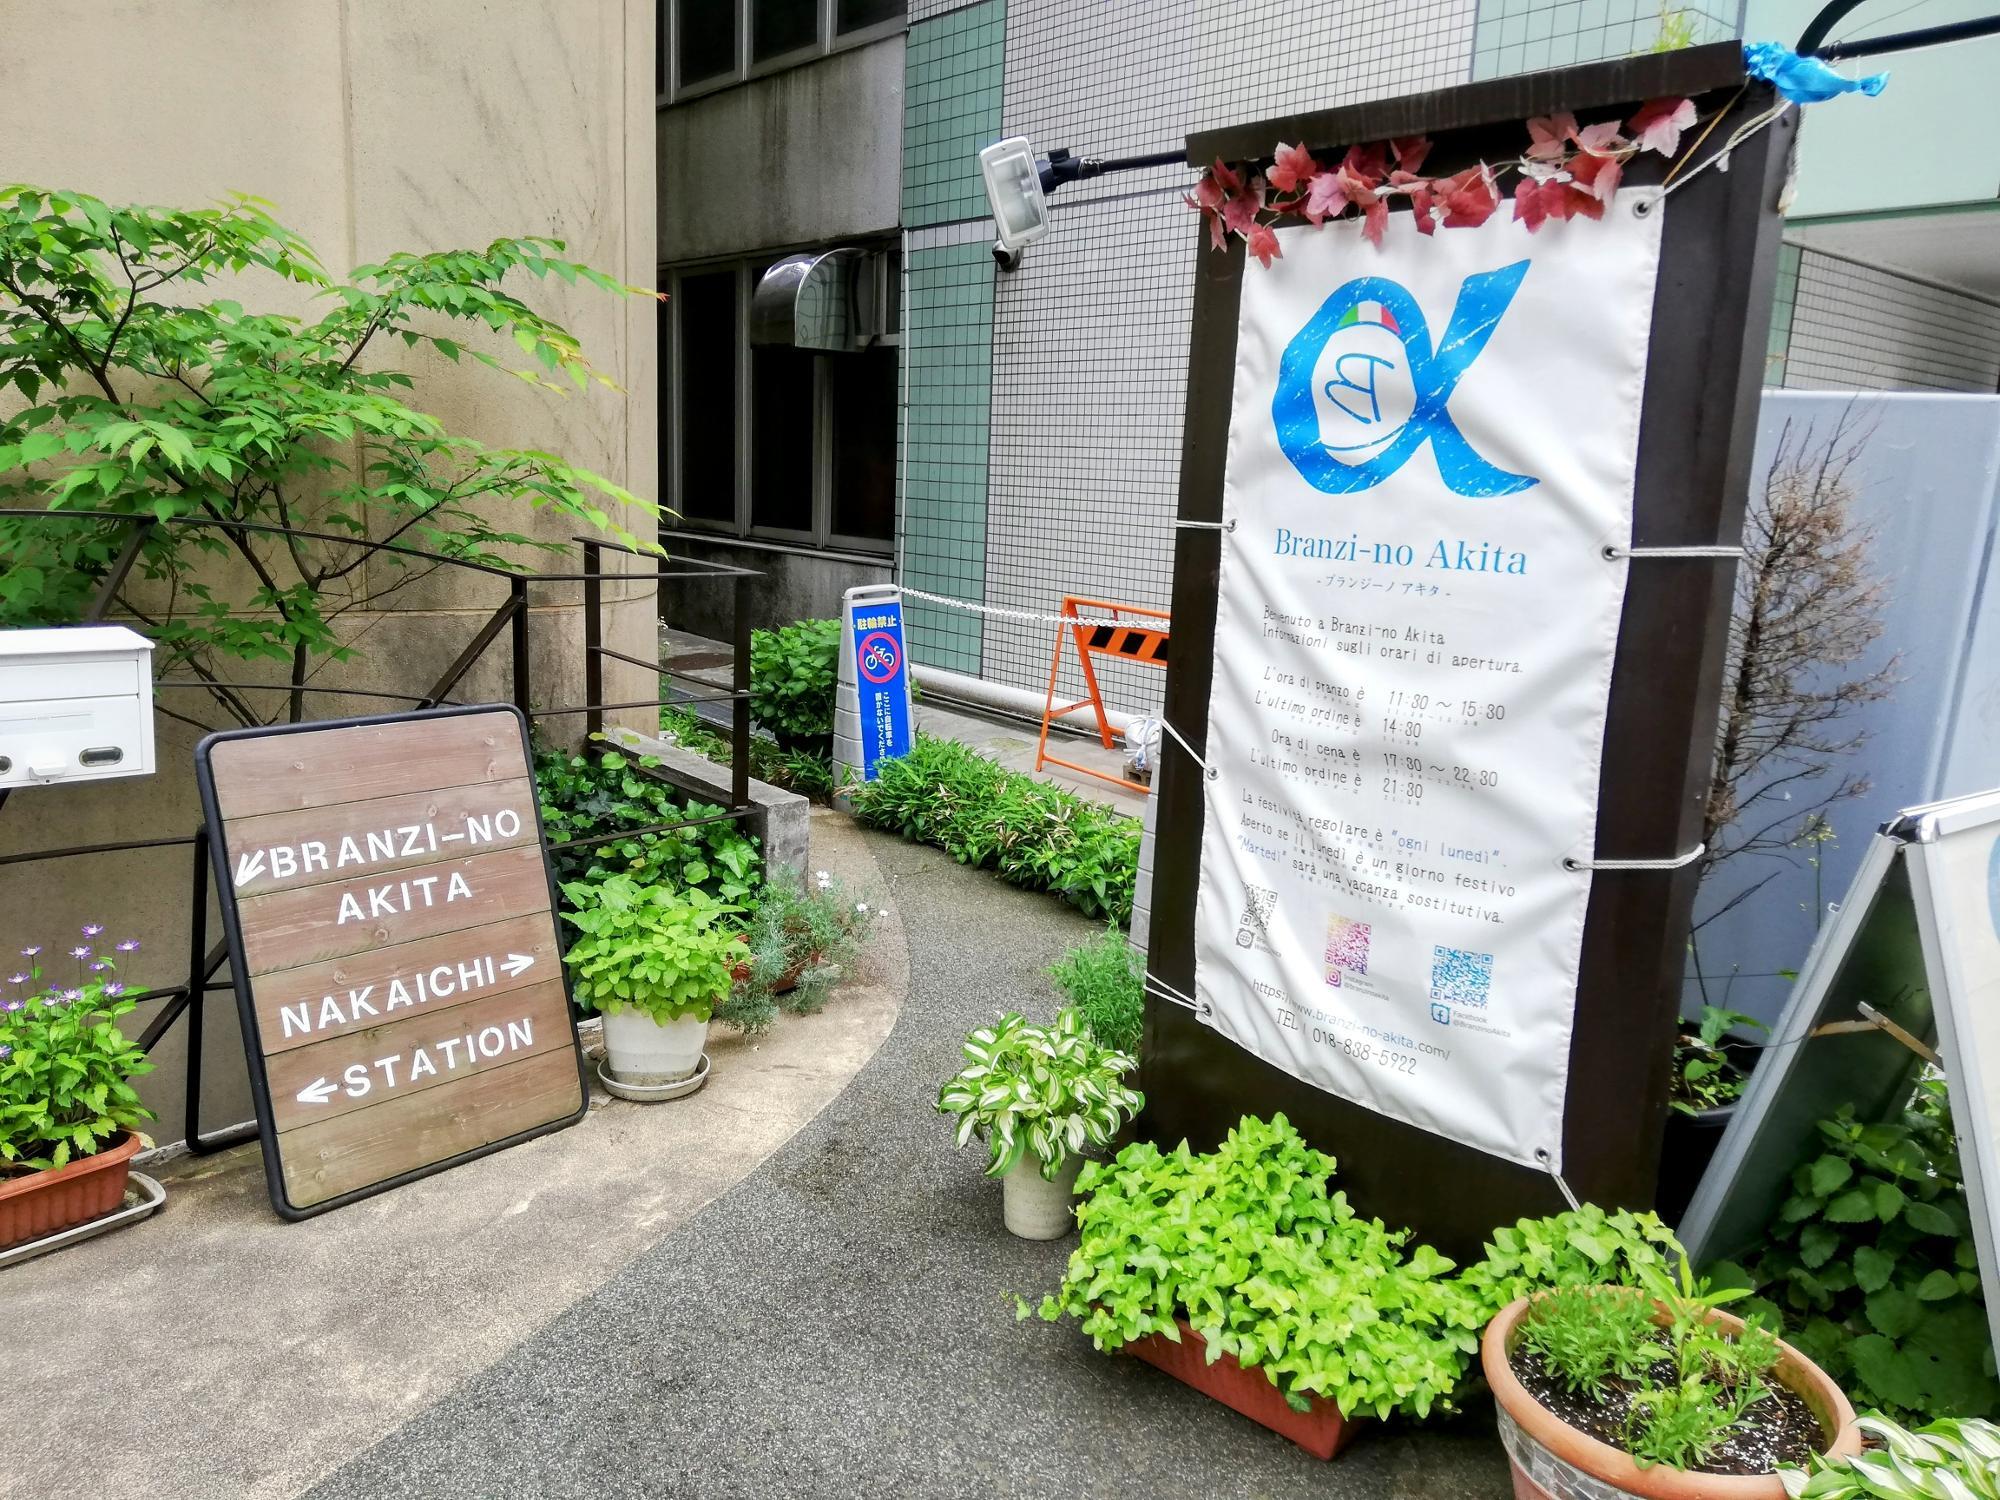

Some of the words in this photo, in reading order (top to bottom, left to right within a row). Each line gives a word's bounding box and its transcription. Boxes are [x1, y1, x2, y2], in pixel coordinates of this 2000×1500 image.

[1273, 528, 1413, 567] Branzi-no
[1424, 539, 1527, 575] Akita
[857, 615, 897, 631] 駐輪禁止
[1263, 604, 1312, 629] Beenuto
[1318, 619, 1325, 630] a
[1331, 616, 1397, 640] Branzi-no
[1405, 626, 1446, 645] Akita
[1337, 640, 1371, 656] sugli
[1380, 647, 1417, 662] orari
[1427, 651, 1441, 665] di
[1451, 654, 1524, 673] apertura.
[1299, 675, 1310, 689] di
[1315, 681, 1350, 698] pranzo
[1356, 686, 1365, 700] è
[1389, 690, 1429, 710] 11:30
[1461, 700, 1505, 720] 15:30
[1311, 707, 1350, 725] ordine
[1354, 714, 1361, 727] è
[1383, 718, 1422, 738] 14:30
[1271, 728, 1292, 746] Ora
[1297, 737, 1308, 751] di
[1316, 744, 1346, 759] cena
[1352, 748, 1361, 760] è
[1304, 766, 1347, 784] ordine
[1354, 772, 1362, 786] è
[1383, 753, 1422, 772] 17:30
[1453, 766, 1498, 787] 22:30
[1383, 777, 1423, 798] 21:30
[1242, 787, 1253, 804] La
[1308, 817, 1368, 839] regolare
[1375, 828, 1383, 842] è
[268, 809, 521, 879] BRANZI-NO
[1240, 812, 1273, 835] Aperto
[1277, 828, 1289, 841] se
[1295, 832, 1303, 847] il
[1355, 851, 1364, 864] è
[1372, 857, 1388, 870] un
[1395, 862, 1445, 883] giorno
[1455, 873, 1516, 897] festivo
[337, 872, 473, 925] AKITA
[1292, 859, 1316, 875] sarà
[1323, 868, 1342, 884] una
[1346, 877, 1399, 900] vacanza
[1407, 892, 1505, 924] sostitutiva.
[280, 955, 496, 1038] NAKAICHI
[344, 1017, 535, 1098] STATION
[1277, 1007, 1299, 1031] TEL
[1313, 1027, 1418, 1076] 018-838-5922
